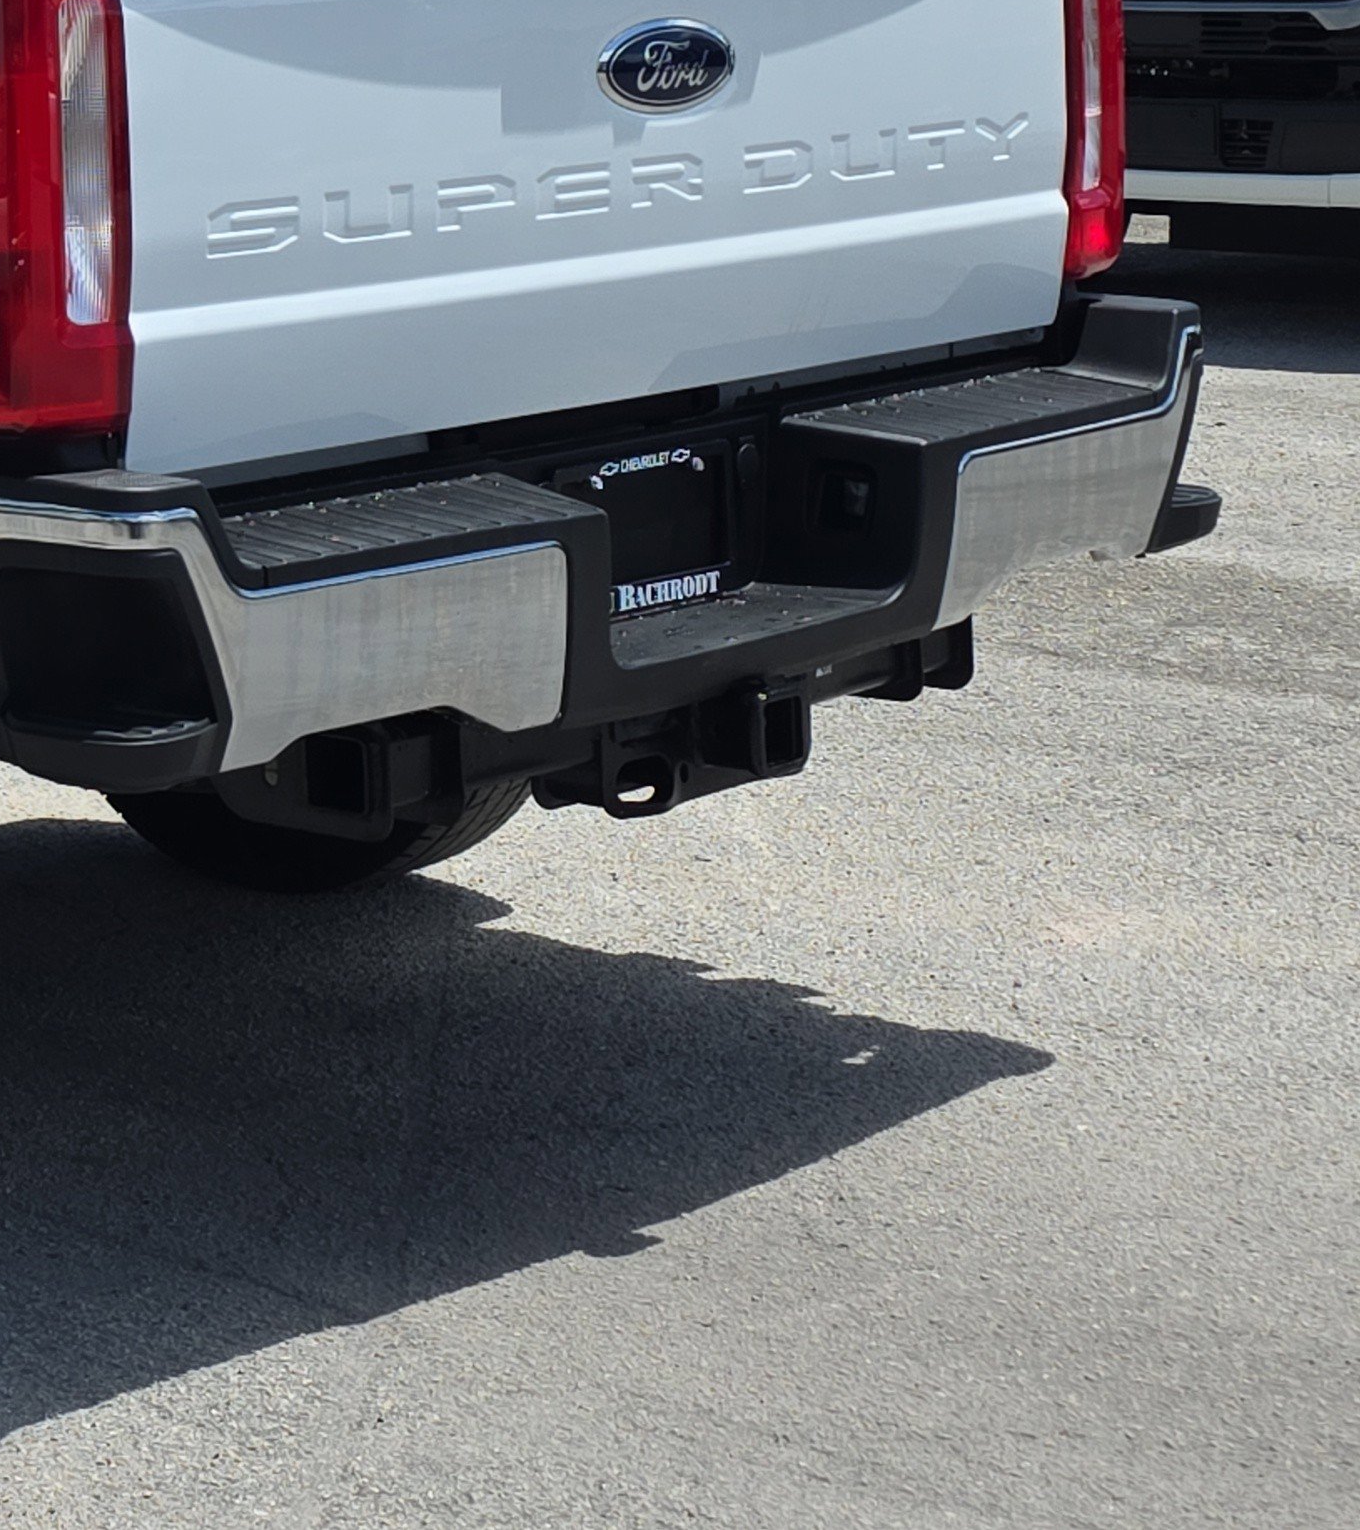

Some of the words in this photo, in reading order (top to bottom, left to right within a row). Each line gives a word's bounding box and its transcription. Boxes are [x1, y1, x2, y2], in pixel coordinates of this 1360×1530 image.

[637, 40, 709, 92] Ford
[206, 153, 703, 259] SUPER
[743, 111, 1029, 195] DUTY
[621, 451, 670, 473] CHEVROLET
[617, 570, 721, 612] BACHRODT
